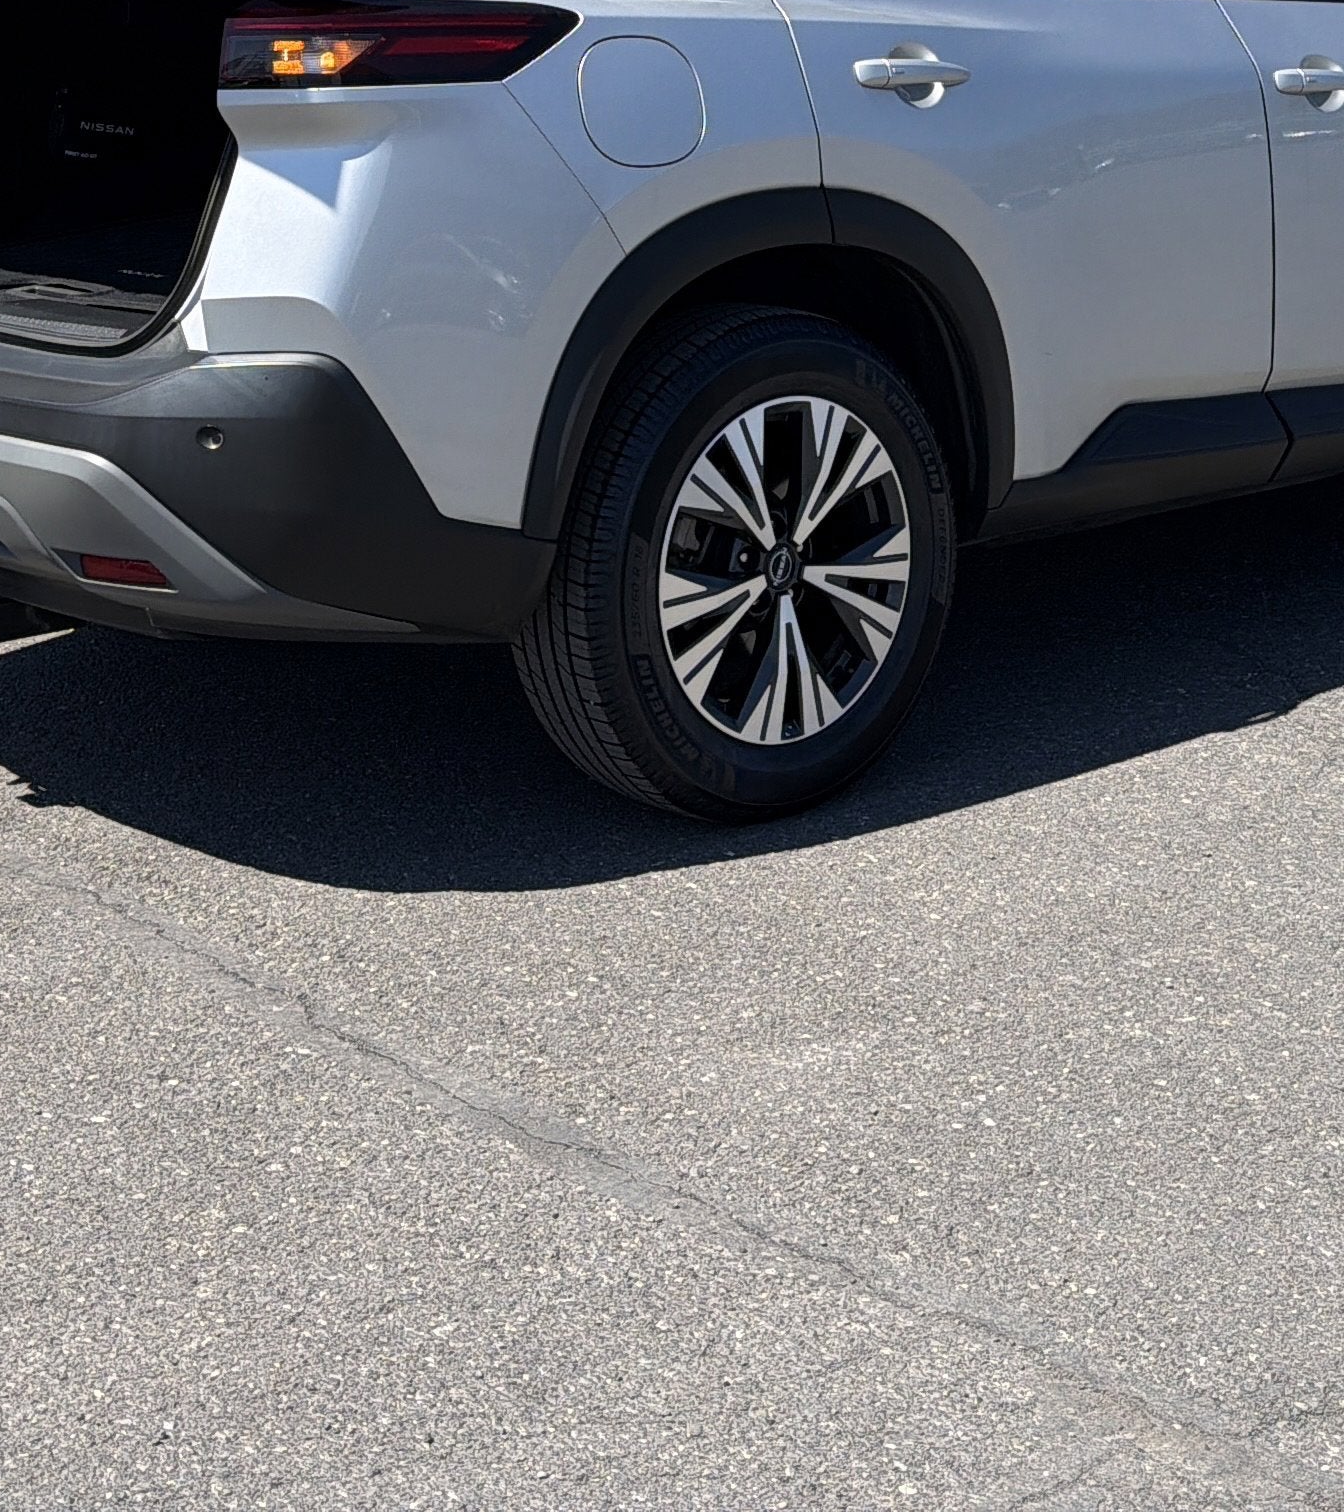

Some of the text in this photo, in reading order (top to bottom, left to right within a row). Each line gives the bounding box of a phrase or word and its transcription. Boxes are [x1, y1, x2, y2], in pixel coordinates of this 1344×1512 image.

[80, 121, 135, 136] NISSAN
[887, 389, 944, 494] MICHELIN
[635, 659, 700, 761] MICHELIN
